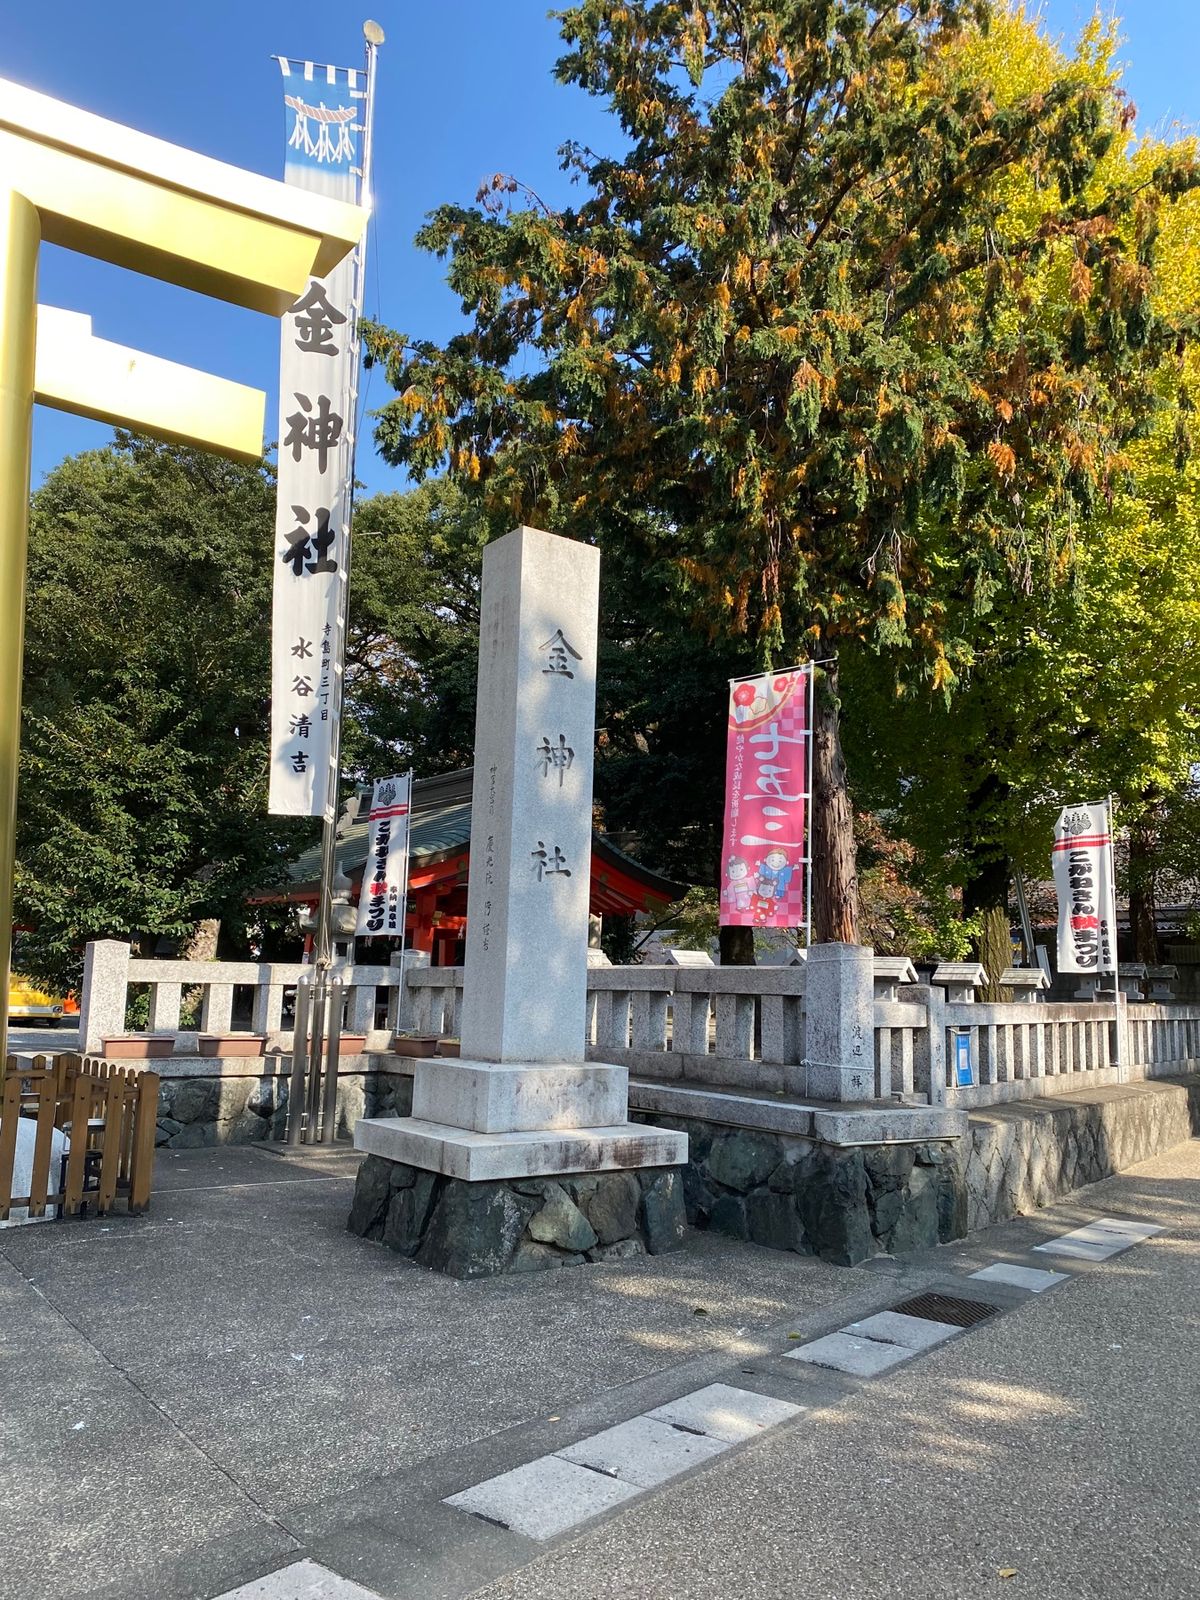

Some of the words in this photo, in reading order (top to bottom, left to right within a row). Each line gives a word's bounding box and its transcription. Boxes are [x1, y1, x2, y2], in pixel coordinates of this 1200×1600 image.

[284, 281, 347, 576] 金神社
[289, 637, 314, 773] 水谷清吉
[531, 629, 583, 882] 金神社
[1068, 850, 1099, 968] こがねさん秋まつり
